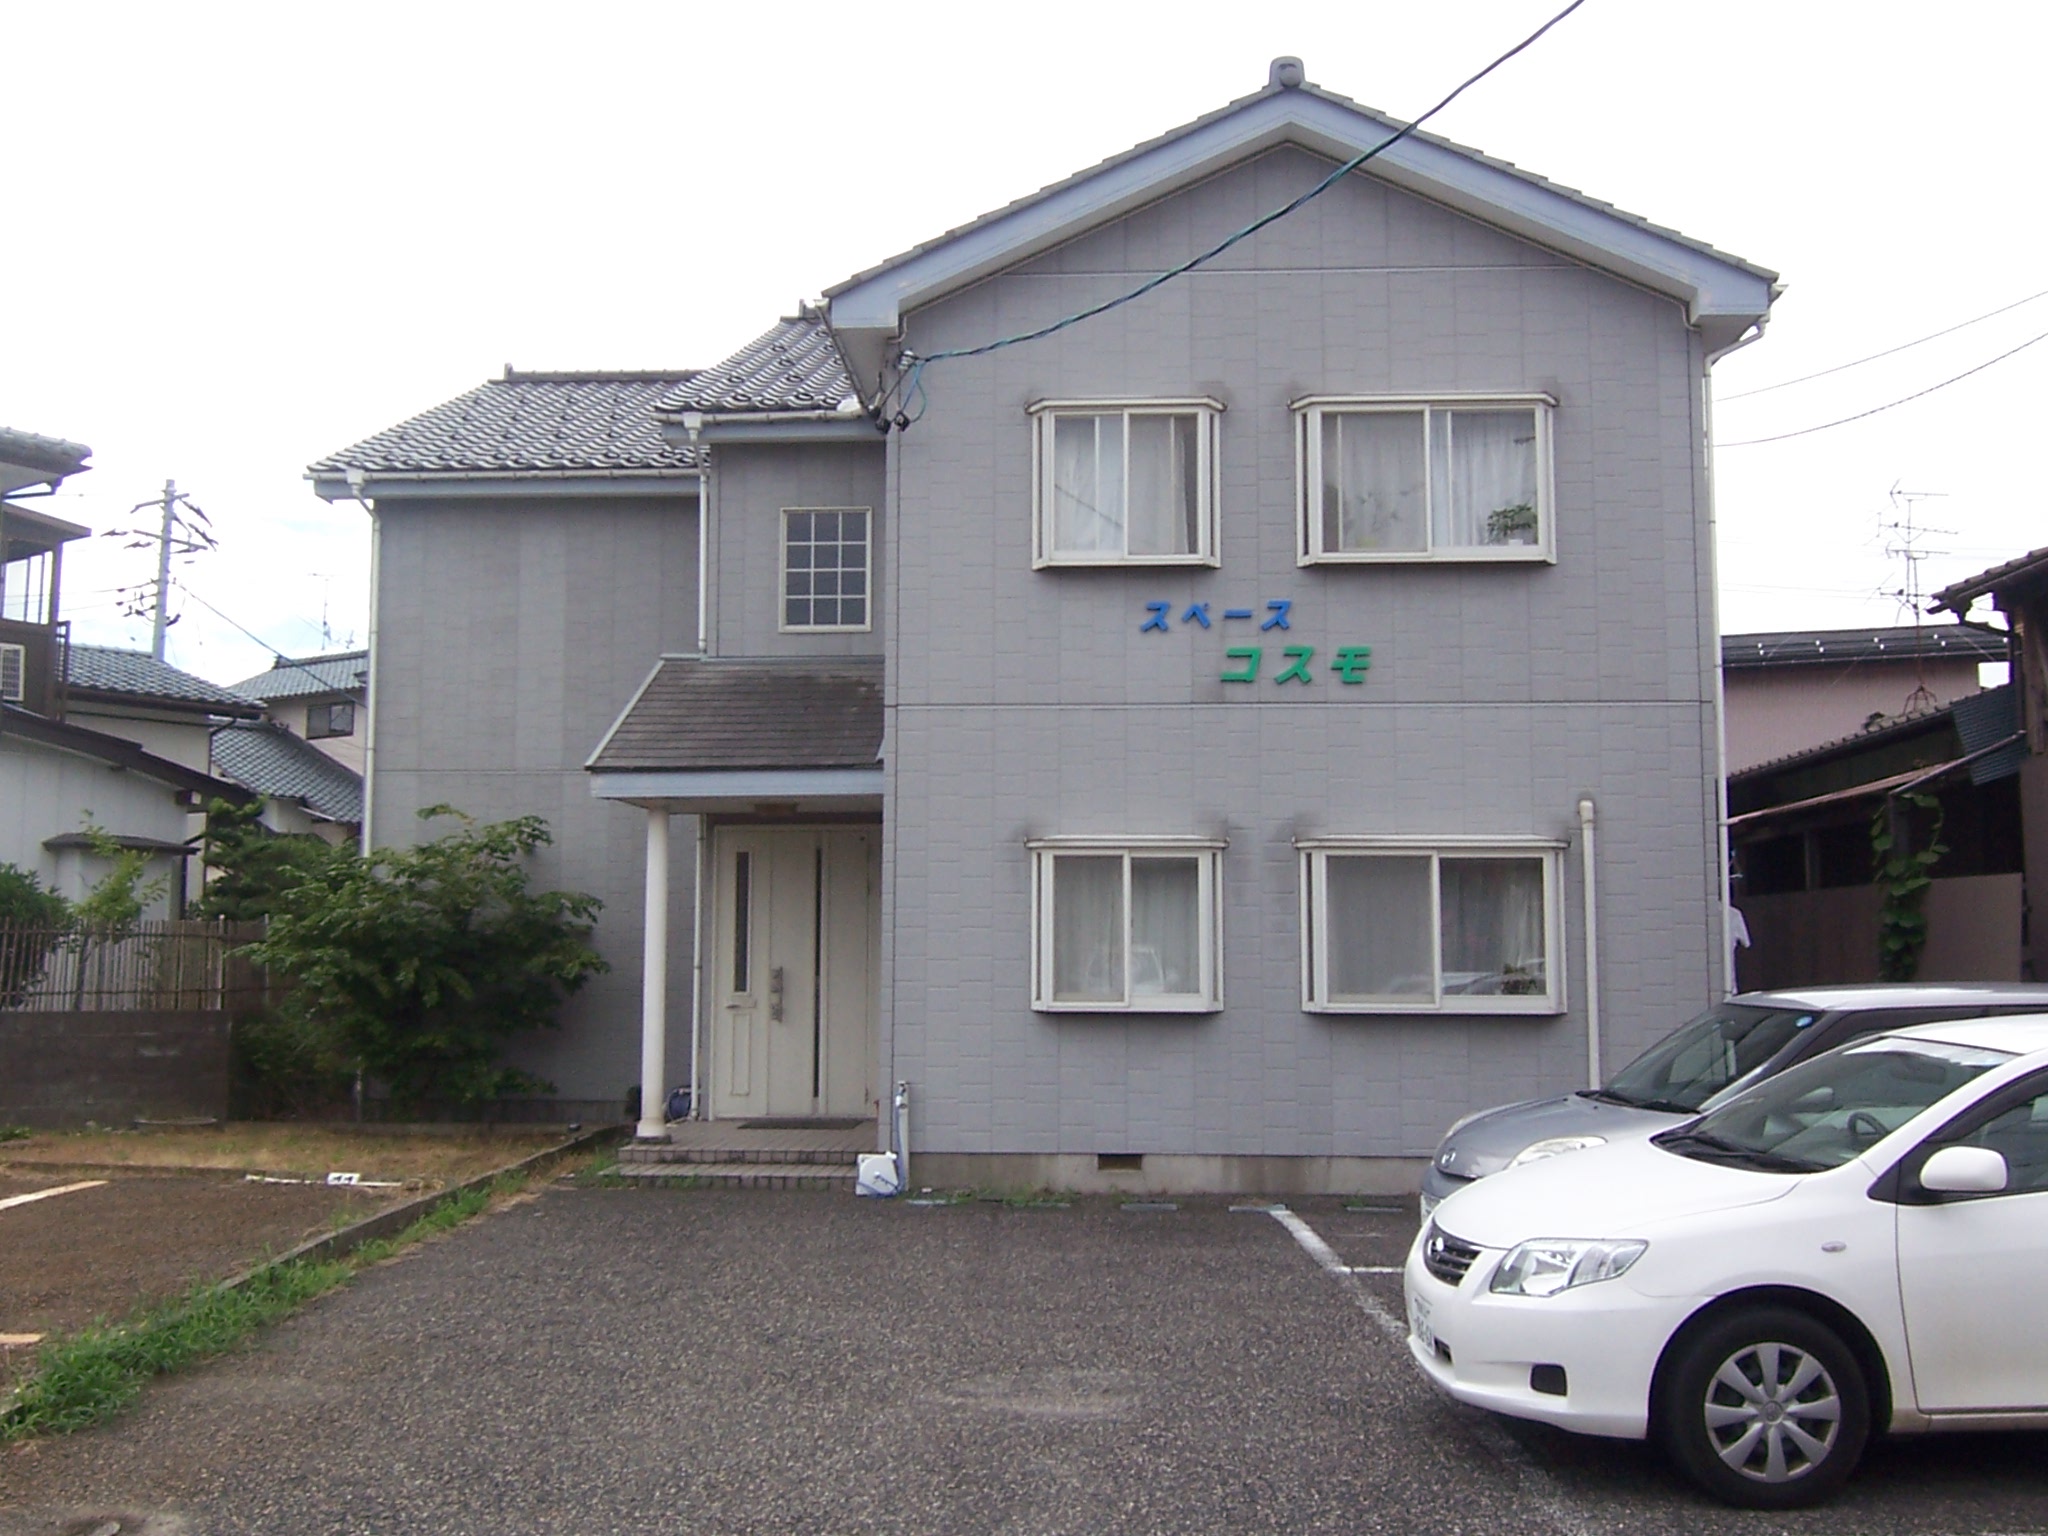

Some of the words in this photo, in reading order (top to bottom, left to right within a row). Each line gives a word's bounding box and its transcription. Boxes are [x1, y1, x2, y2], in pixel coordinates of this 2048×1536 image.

[1140, 600, 1292, 632] スペース
[1220, 646, 1371, 684] コスモ
